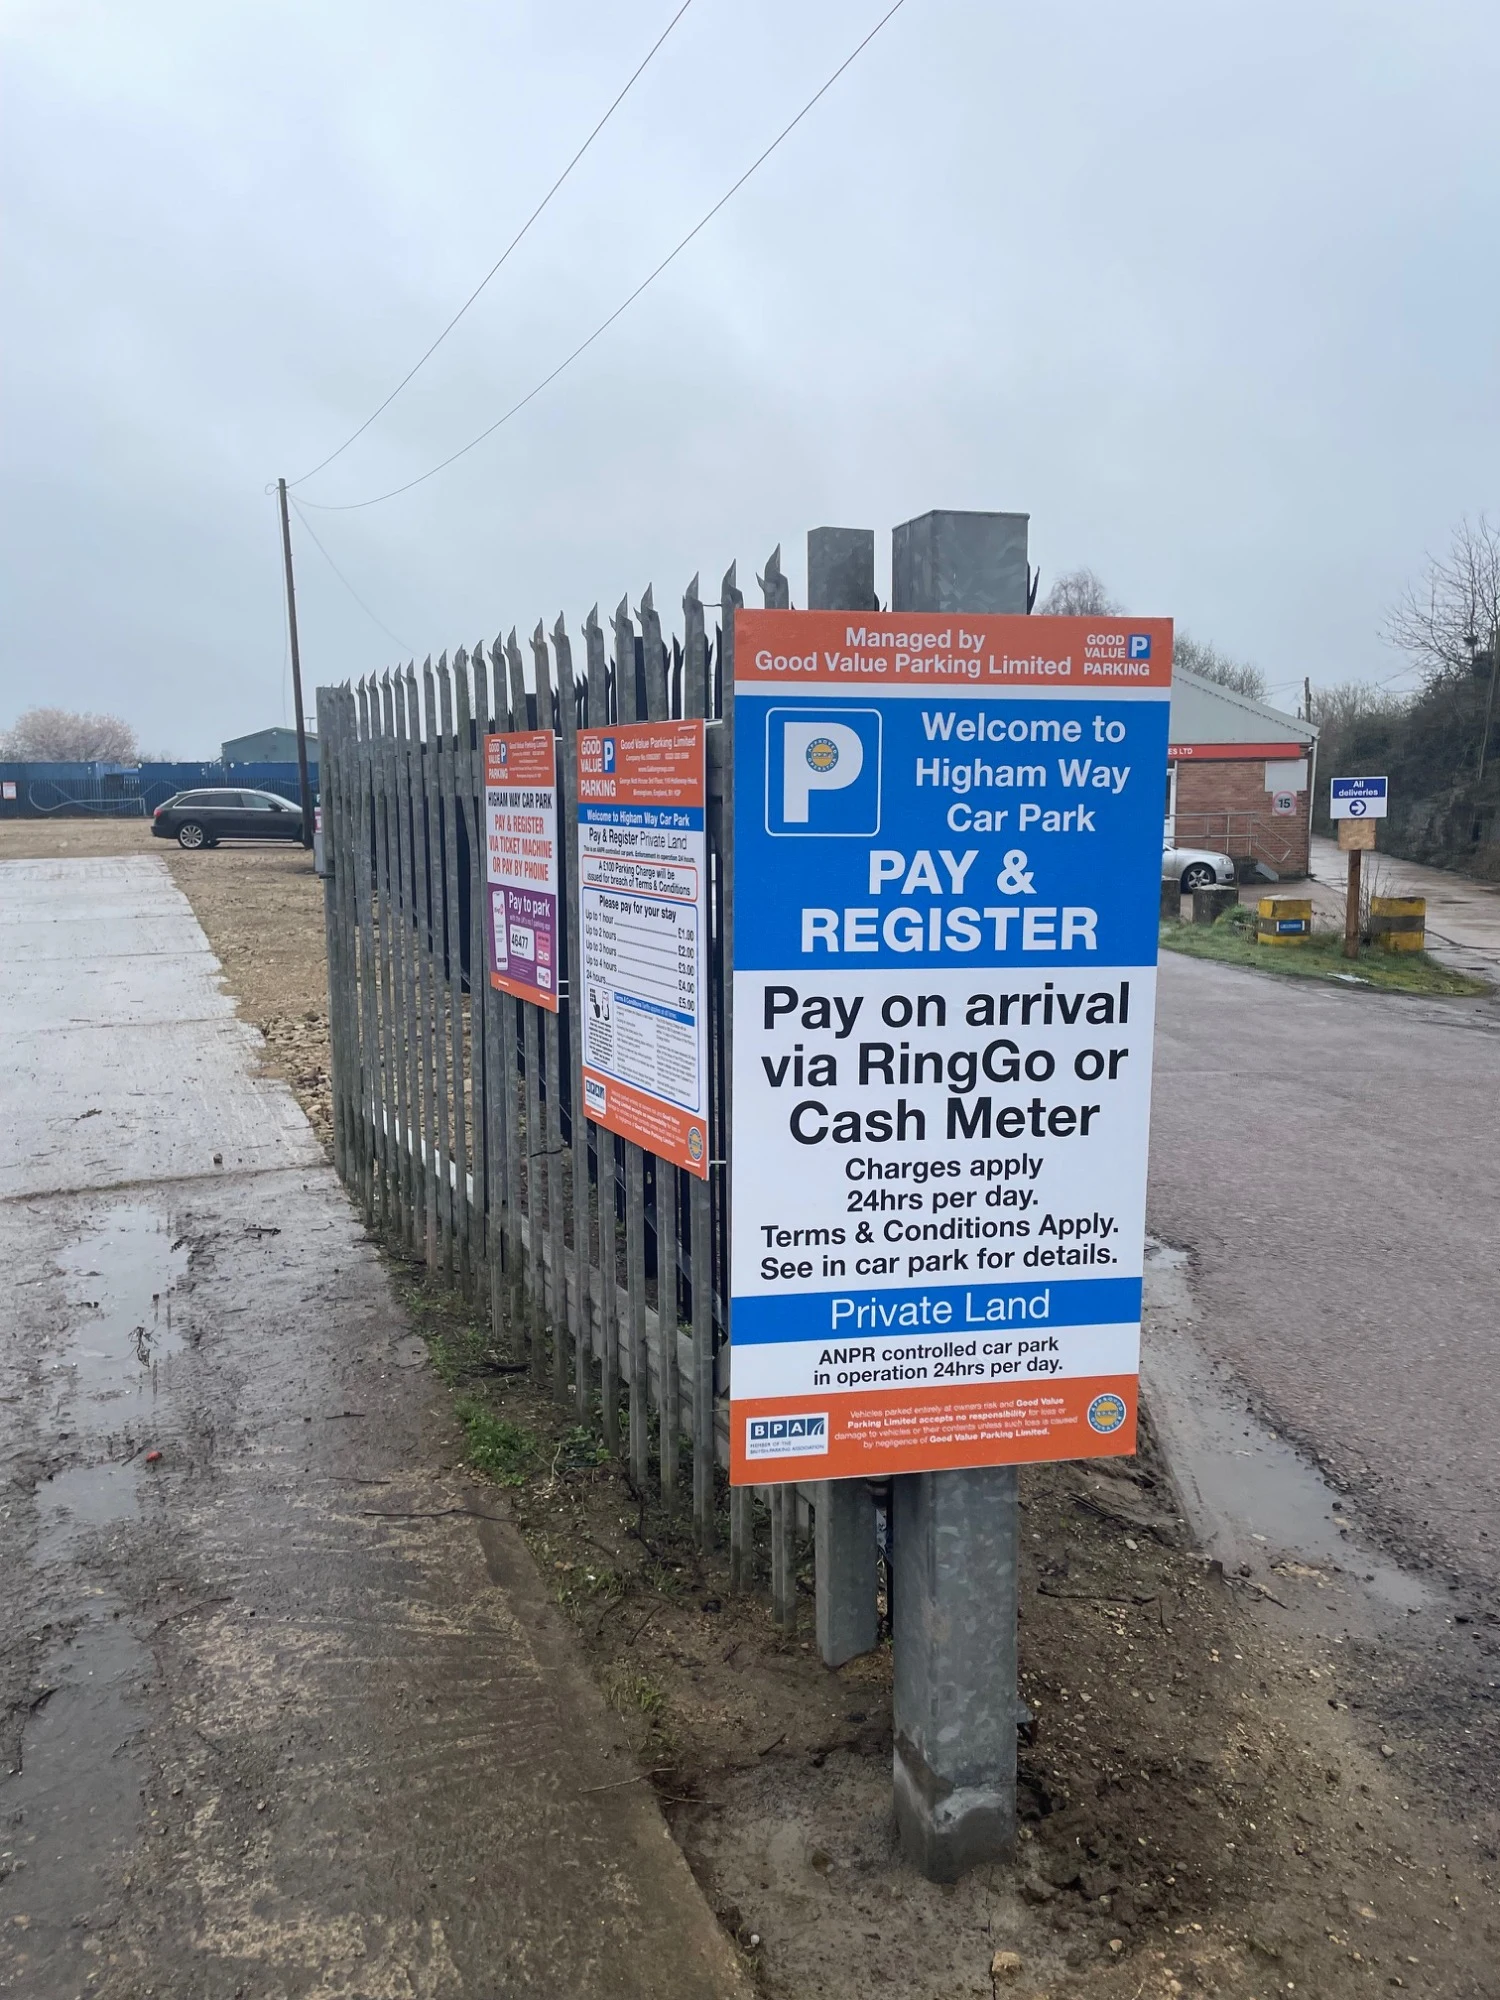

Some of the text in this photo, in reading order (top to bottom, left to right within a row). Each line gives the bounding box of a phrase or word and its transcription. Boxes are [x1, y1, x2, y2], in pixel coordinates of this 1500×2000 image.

[846, 627, 986, 652] Managed by
[1086, 634, 1125, 646] GOOD
[755, 651, 1071, 678] Good Value Parking Limited
[1085, 647, 1126, 659] VALUE
[1084, 662, 1150, 676] PARKING
[921, 711, 1126, 743] Welcome to
[581, 740, 601, 755] GOOD
[620, 739, 634, 749] Good
[650, 737, 673, 749] Parking
[674, 735, 696, 747] Limited
[581, 758, 602, 773] VALUE
[783, 721, 864, 823] P
[916, 758, 1131, 794] Higham Way
[581, 780, 616, 797] PARKING
[1338, 789, 1378, 797] deliveries
[1353, 780, 1364, 788] All
[509, 792, 521, 807] WAY
[522, 793, 534, 808] CAR
[536, 793, 552, 809] PARK
[1279, 798, 1290, 808] 15
[495, 814, 544, 834] PAY REGISTER
[587, 809, 690, 827] Welcome to Higham Way Car Park
[947, 803, 1096, 832] Car Park
[489, 835, 552, 858] VIA TICKET MACHINE
[589, 827, 687, 850] Pay & Register Private Land
[493, 856, 548, 881] OR PAY BY PHONE
[603, 861, 675, 880] £100 Parking Charge be
[869, 848, 1037, 896] PAY &
[587, 871, 691, 896] issued breach Terms Conditions
[509, 892, 522, 914] Pay
[523, 896, 531, 913] to
[532, 899, 550, 918] park
[599, 895, 676, 923] Please pay for your stay
[603, 914, 614, 924] hour
[802, 906, 1098, 952] REGISTER
[603, 928, 617, 941] hours
[603, 944, 617, 956] hours
[678, 944, 694, 959] £2.00
[603, 959, 617, 972] hours
[593, 971, 606, 985] hours
[763, 981, 1129, 1039] Pay on arrival
[761, 1039, 1129, 1094] via RingGo or
[789, 1096, 1100, 1145] Cash Meter
[845, 1153, 1044, 1184] Charges apply
[847, 1185, 1039, 1213] 24hrs per day.
[760, 1212, 1119, 1248] Terms & Conditions Apply.
[760, 1243, 1118, 1280] See in car park for details.
[832, 1289, 1050, 1330] Private Land
[819, 1336, 1059, 1365] ANPR controlled car park
[814, 1356, 1063, 1387] in operation 24hrs per day.
[848, 1419, 881, 1430] Parking
[883, 1417, 917, 1427] Limited
[919, 1414, 953, 1425] accepts
[956, 1413, 967, 1421] no
[969, 1409, 1026, 1421] responsibility
[1028, 1408, 1039, 1416] for
[1041, 1408, 1056, 1416] loss
[850, 1397, 1064, 1418] Vehicles parked entirely at owners risk and Good Value
[755, 1422, 803, 1436] BPA
[834, 1431, 867, 1442] damage
[879, 1428, 911, 1437] vehicles
[922, 1425, 941, 1434] their
[942, 1423, 976, 1432] contents
[977, 1421, 1002, 1429] unless
[1004, 1418, 1023, 1427] such
[1025, 1418, 1040, 1426] loss
[1050, 1416, 1078, 1425] caused
[863, 1428, 1050, 1450] by negligence of Good Value Parking Limited.
